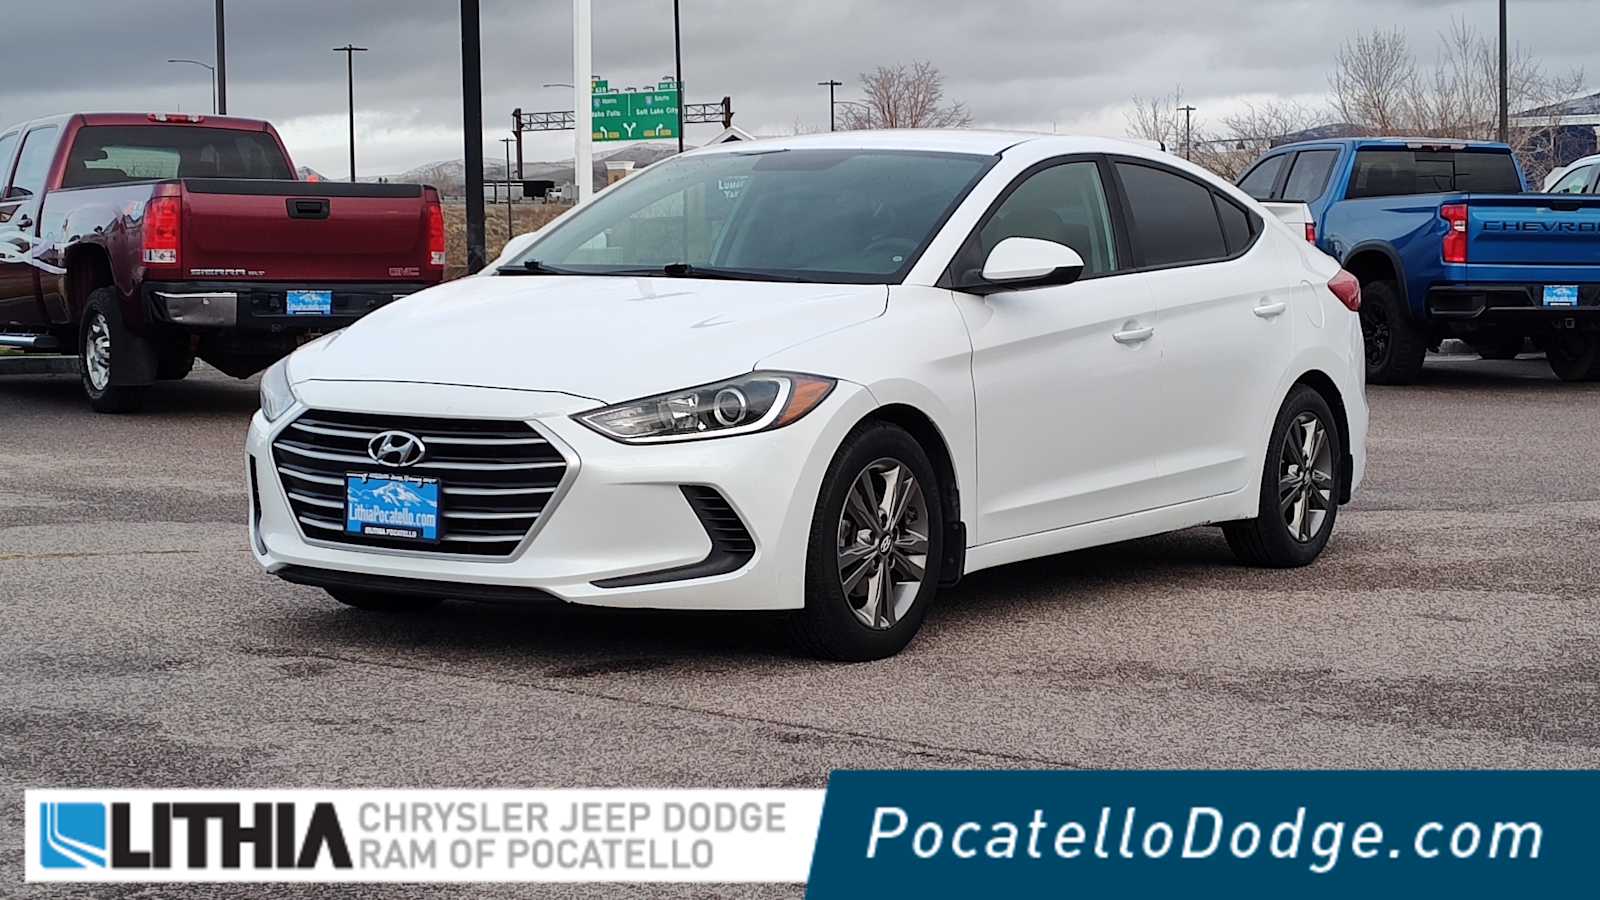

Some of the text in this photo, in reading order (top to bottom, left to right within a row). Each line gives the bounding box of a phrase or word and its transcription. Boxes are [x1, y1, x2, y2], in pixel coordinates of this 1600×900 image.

[1483, 220, 1600, 232] CHEVRO
[190, 268, 246, 276] SIERRA
[348, 502, 437, 528] LithiaPocatello.com
